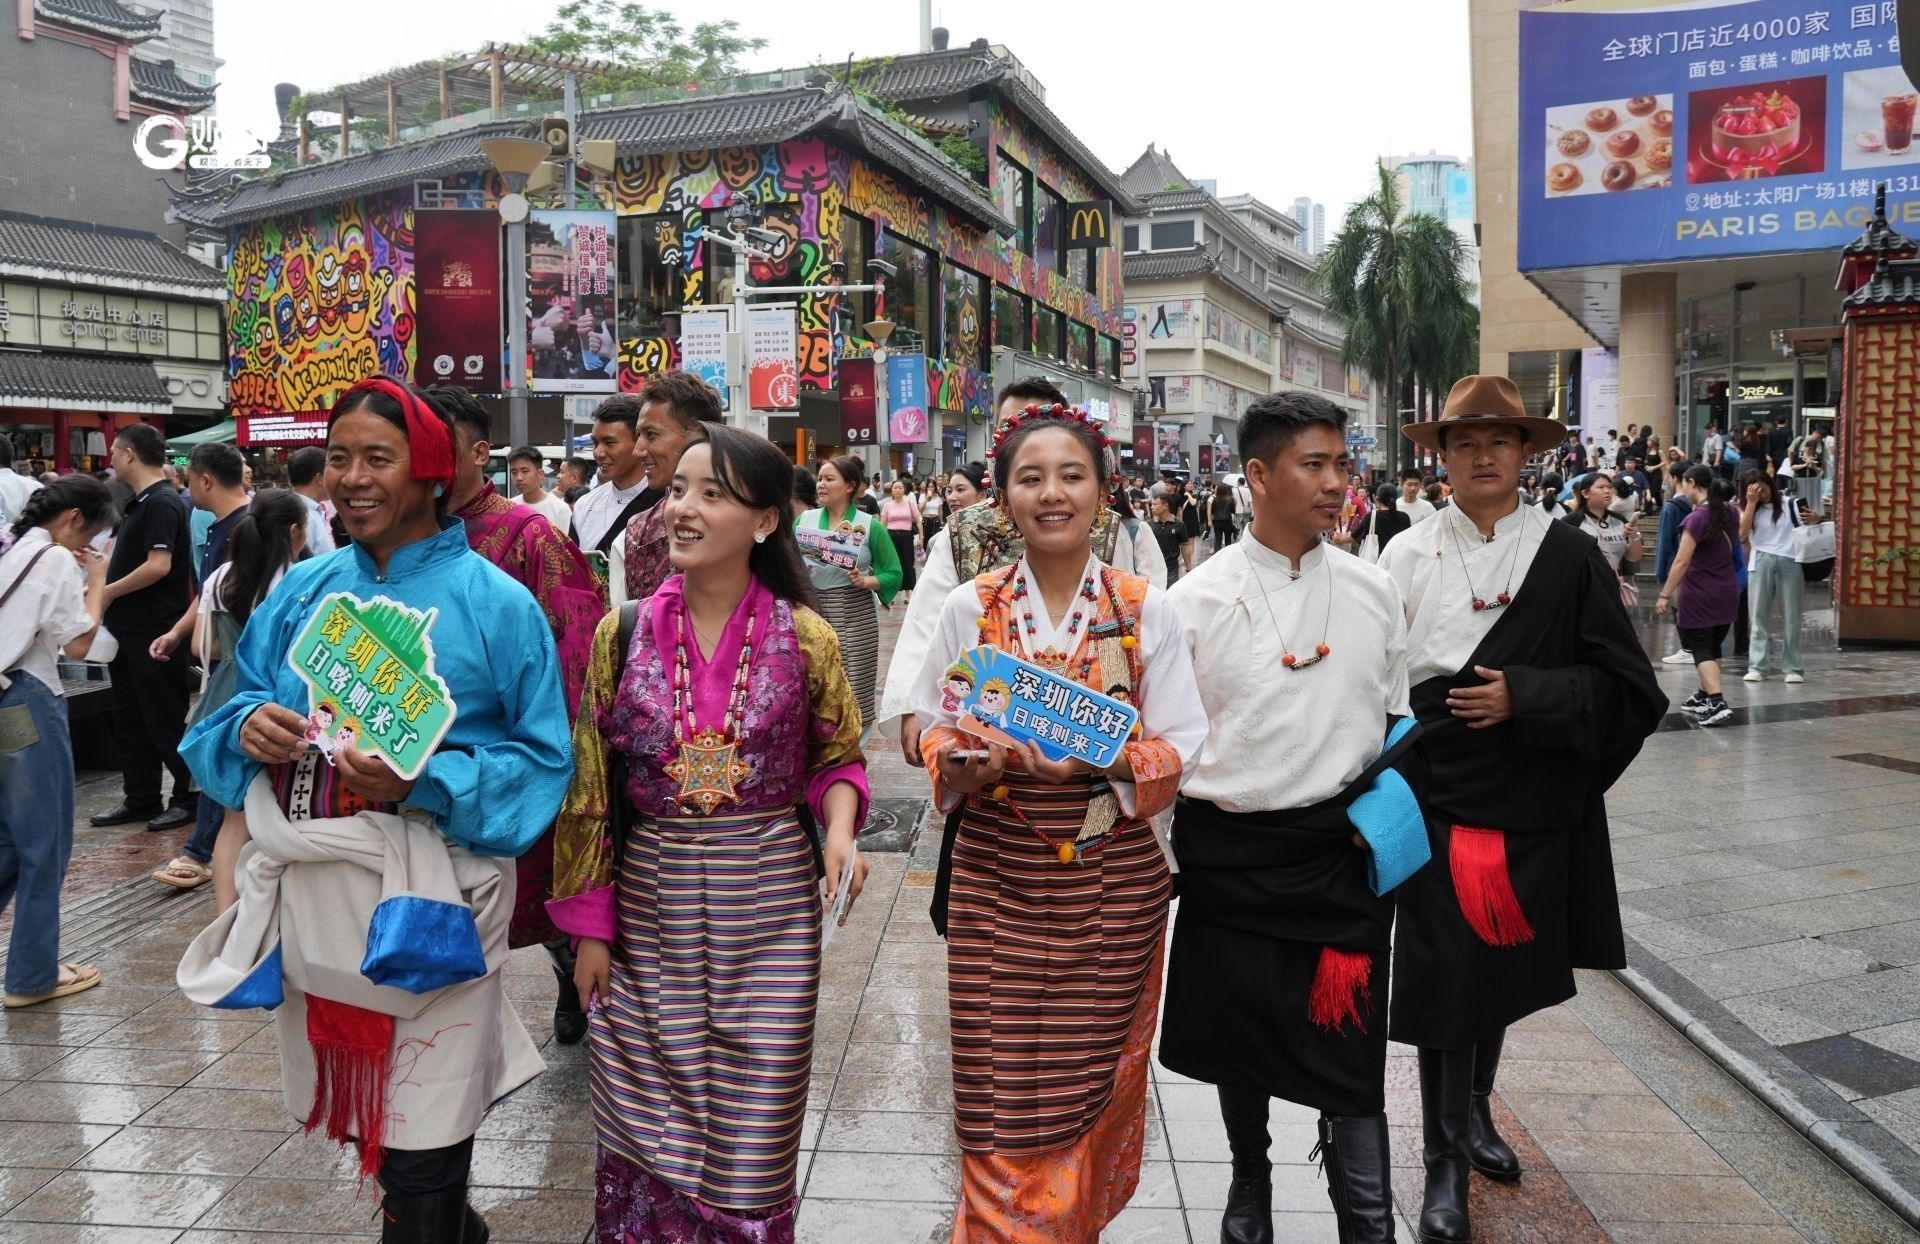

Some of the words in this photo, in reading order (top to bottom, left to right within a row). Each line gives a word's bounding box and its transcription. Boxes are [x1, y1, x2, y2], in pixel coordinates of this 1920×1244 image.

[1603, 11, 1830, 62] 全球门店近4000家
[578, 224, 591, 295] 赞诚信商家
[594, 224, 608, 295] 树诚信意识
[1676, 213, 1780, 240] PARIS
[62, 300, 165, 327] 视光中心店
[307, 641, 419, 754] 日喀则来了
[320, 607, 434, 722] 深圳你好
[1010, 667, 1130, 741] 深圳你好
[1012, 706, 1110, 761] 日喀则来了
